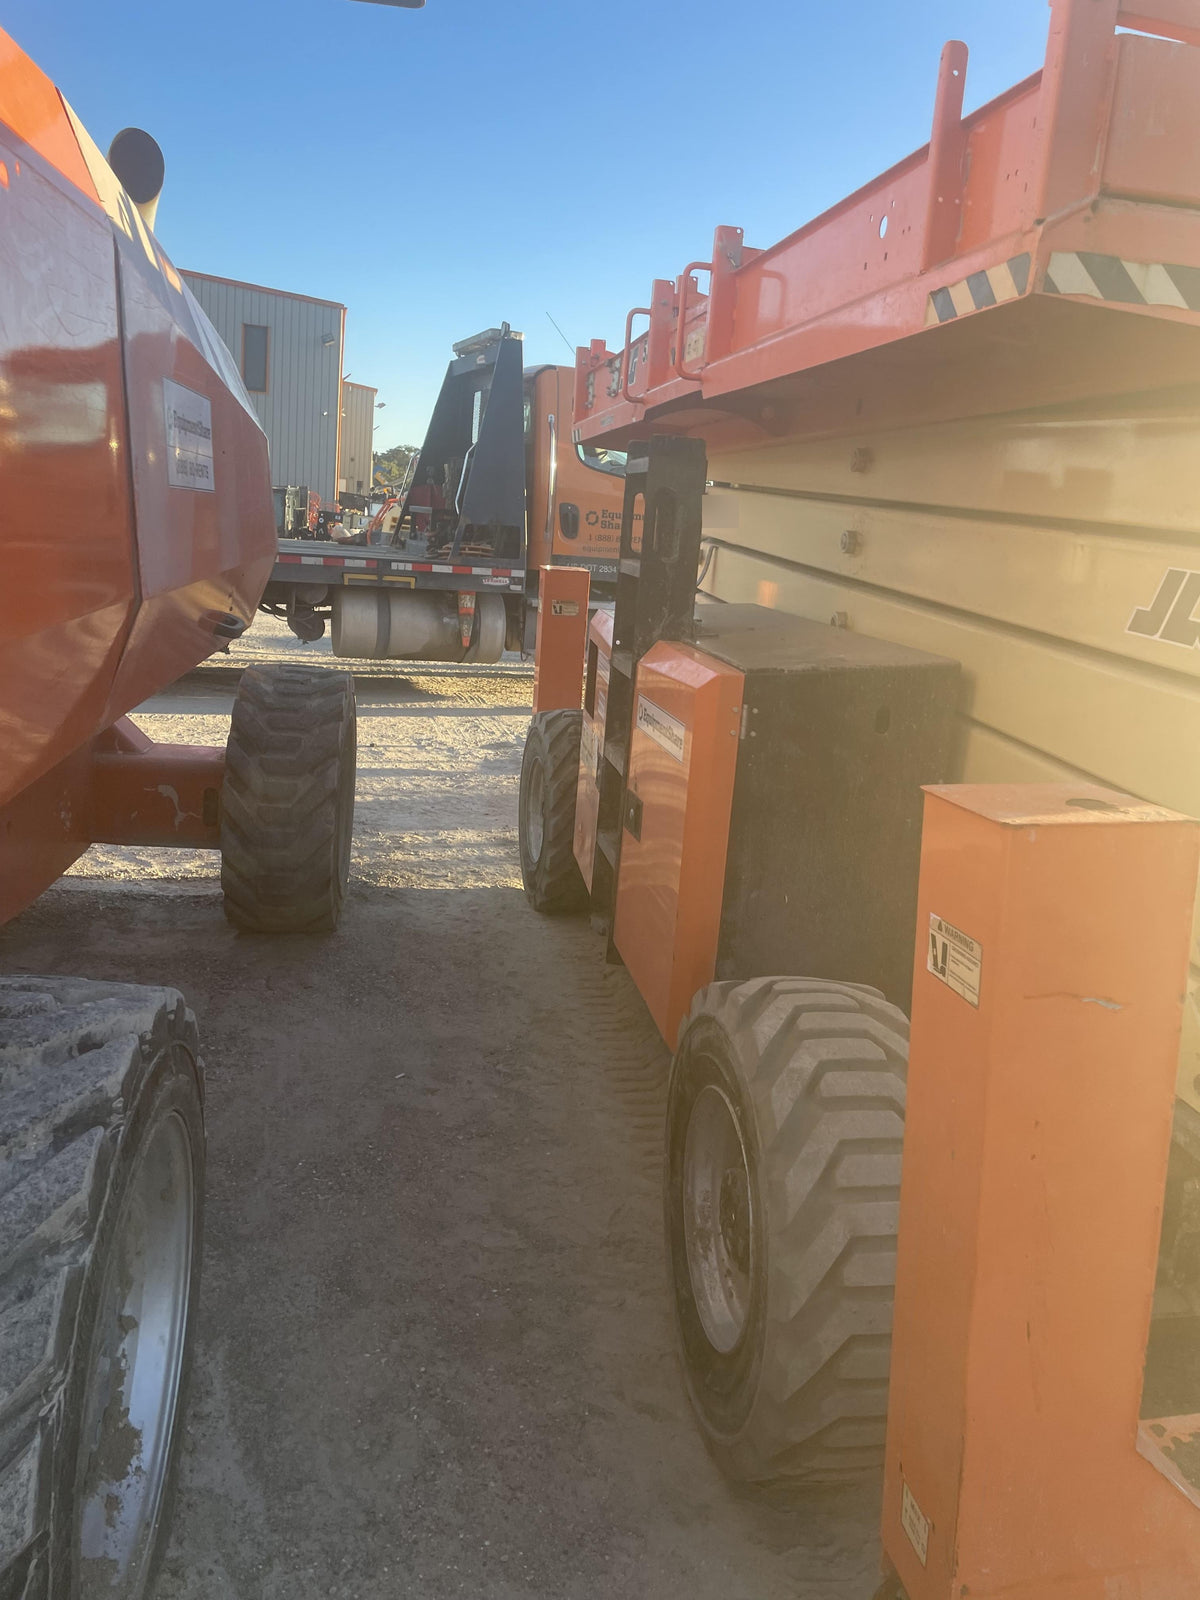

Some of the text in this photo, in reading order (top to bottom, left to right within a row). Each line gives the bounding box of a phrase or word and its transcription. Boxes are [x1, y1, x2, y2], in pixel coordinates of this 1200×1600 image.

[600, 520, 621, 530] Sha
[1124, 566, 1200, 650] JL
[943, 924, 975, 952] WARNING
